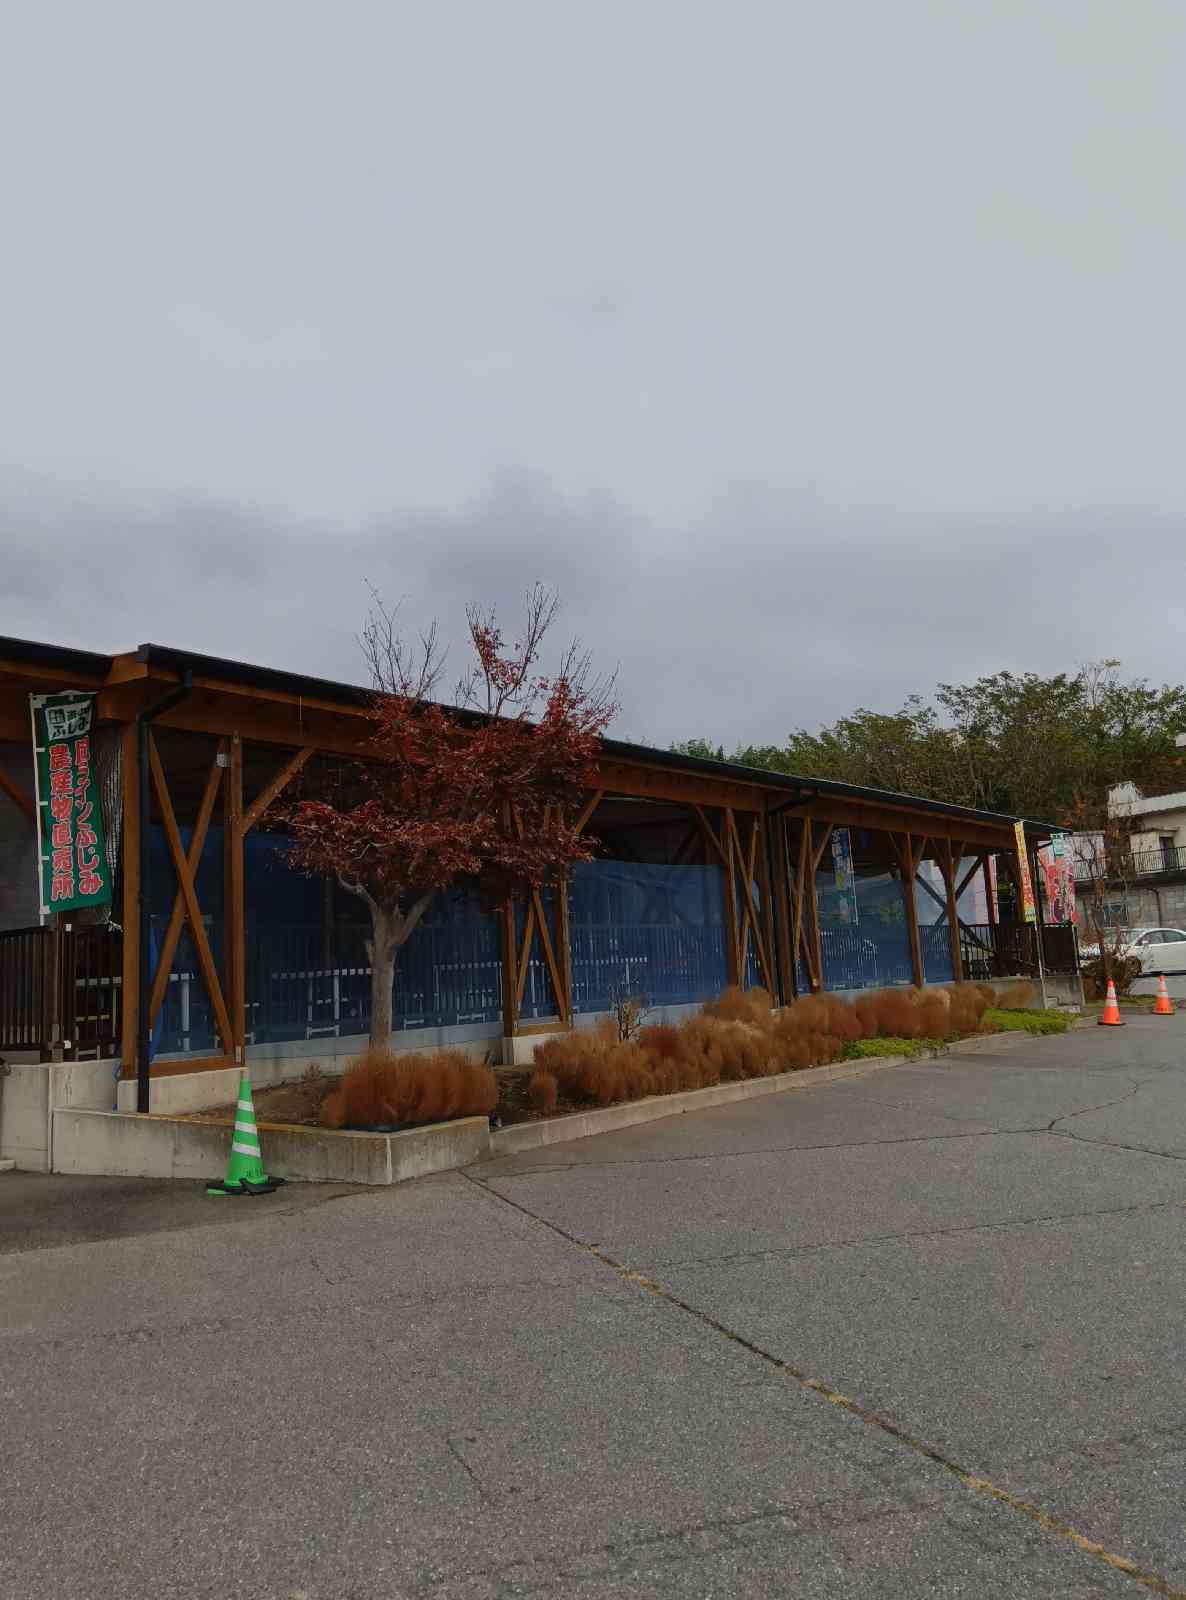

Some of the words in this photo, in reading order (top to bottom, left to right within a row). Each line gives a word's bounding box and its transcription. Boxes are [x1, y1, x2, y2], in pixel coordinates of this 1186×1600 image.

[48, 743, 74, 901] 農産物直売所
